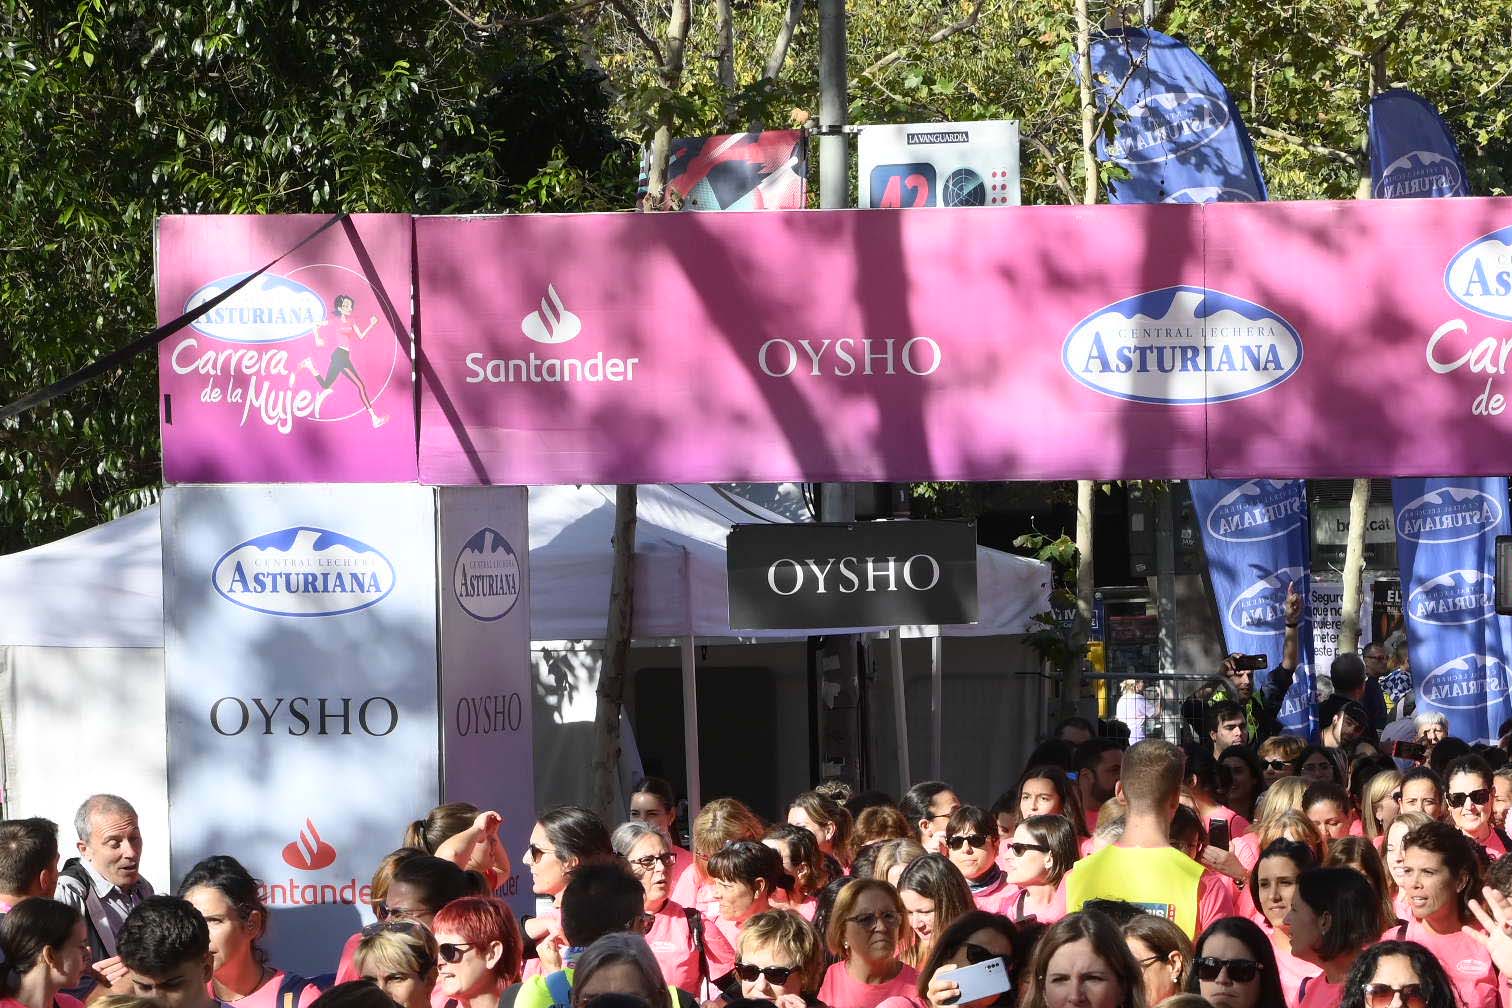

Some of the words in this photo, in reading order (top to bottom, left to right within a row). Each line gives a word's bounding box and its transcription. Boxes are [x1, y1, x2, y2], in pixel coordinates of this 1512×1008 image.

[1118, 327, 1194, 340] CENTRAL
[1201, 324, 1277, 339] LECHERA
[171, 338, 289, 376] Carrera
[466, 351, 639, 385] Santander
[758, 336, 942, 378] OYSHO
[1083, 331, 1284, 375] ASTURIANA
[200, 378, 223, 403] de
[227, 378, 243, 403] la
[240, 372, 333, 434] Mujer
[1472, 380, 1507, 416] de
[228, 560, 382, 594] ASTURIANA
[459, 562, 517, 599] ASTURIANA
[767, 554, 941, 597] OYSHO
[1313, 619, 1344, 632] quiere
[210, 696, 400, 736] OYSHO
[456, 693, 522, 737] OYSHO
[257, 878, 373, 905] antande
